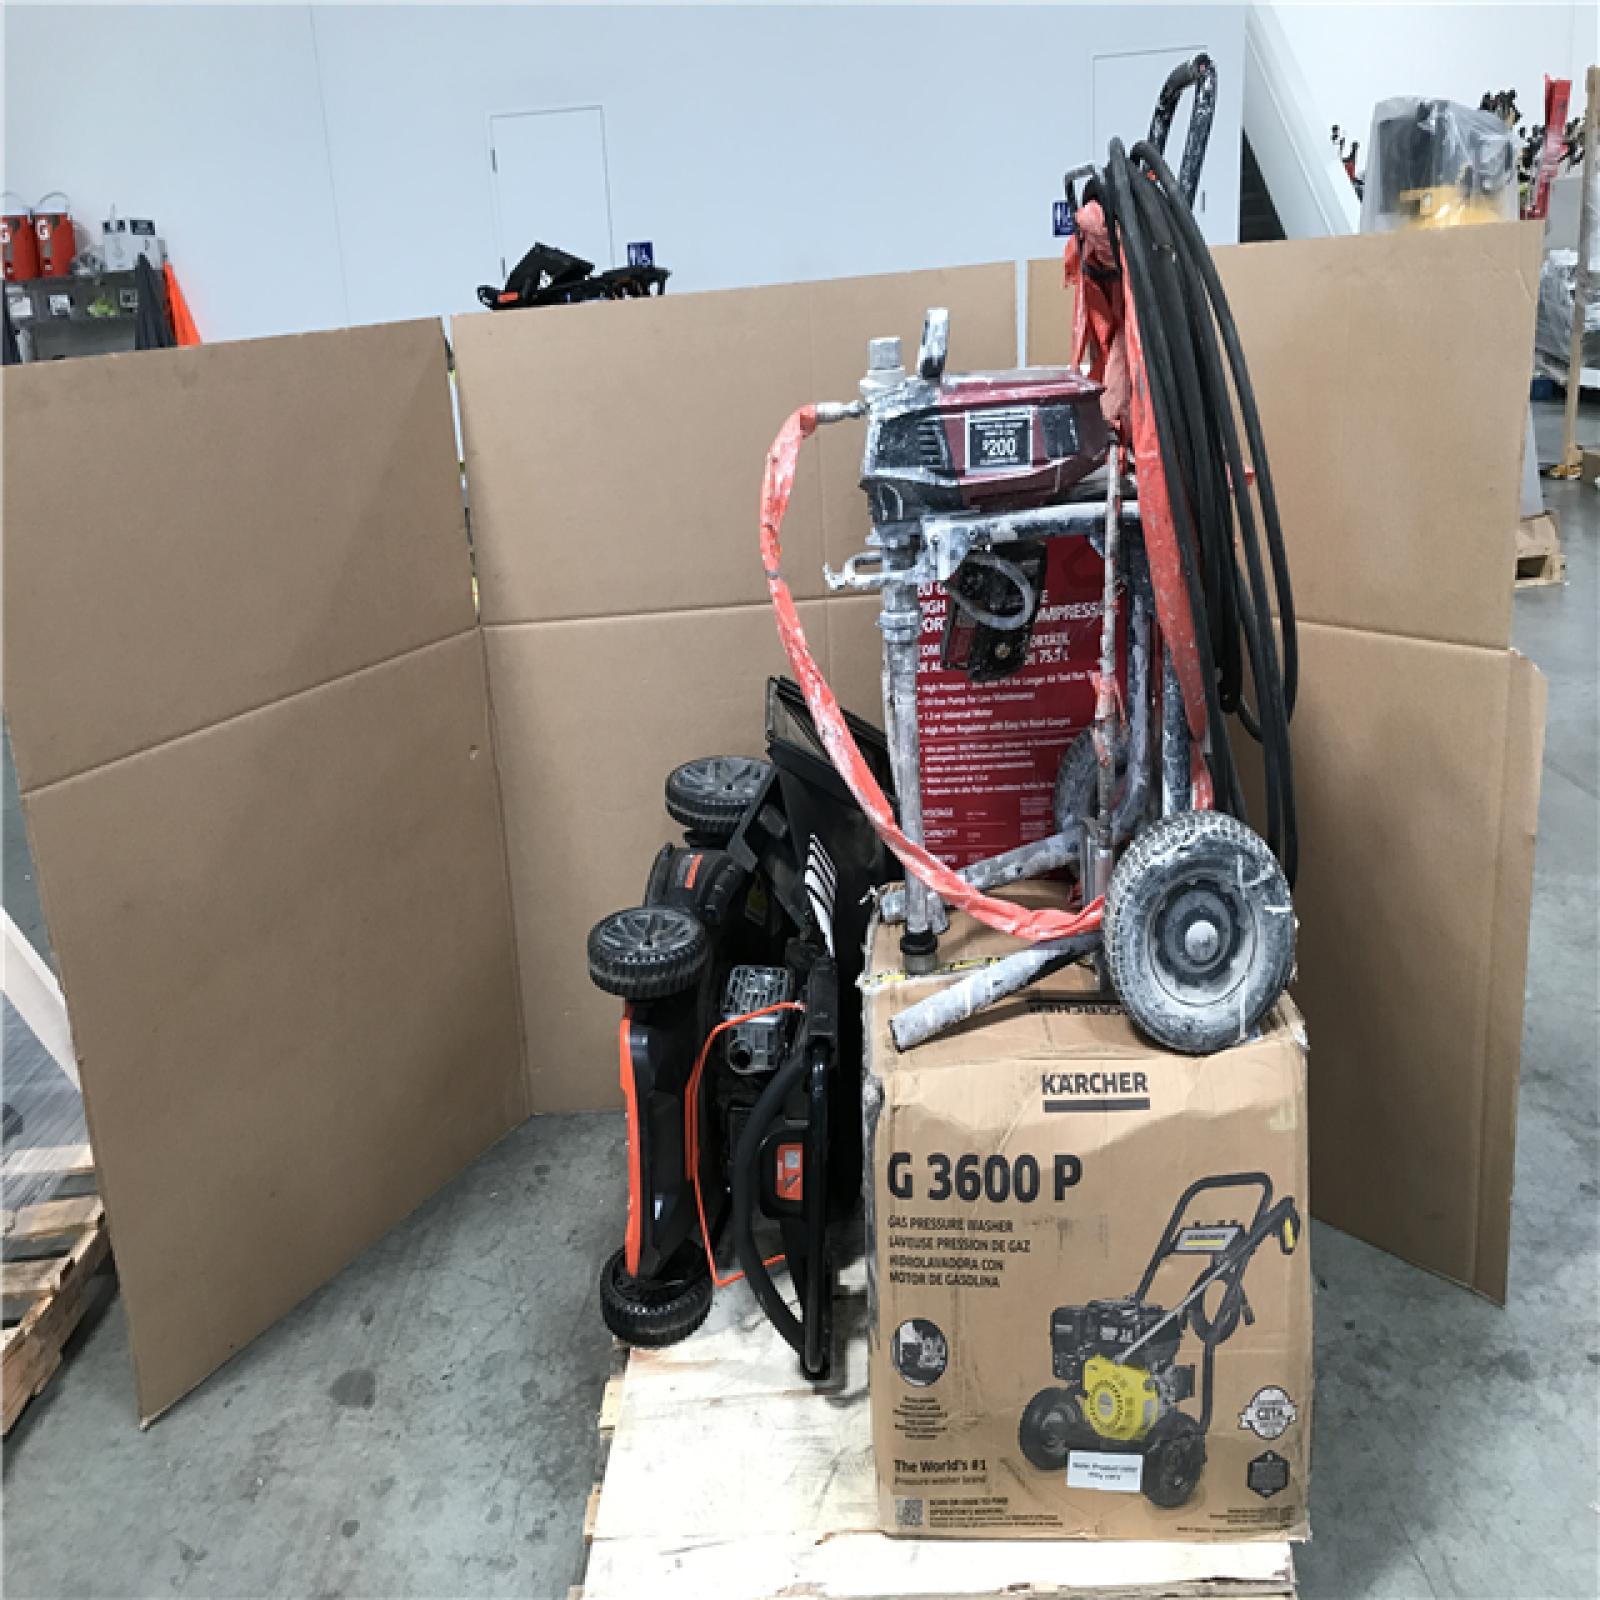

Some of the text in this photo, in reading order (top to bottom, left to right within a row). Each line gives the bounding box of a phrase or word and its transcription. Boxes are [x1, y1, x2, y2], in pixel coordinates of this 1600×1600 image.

[36, 219, 49, 240] G
[1041, 1071, 1148, 1095] KÄRCHER
[888, 1151, 1083, 1203] G 3600 P
[888, 1214, 1014, 1233] GAS PRESSURE WASHER
[889, 1235, 1030, 1253] LAVEUSE PRESSION DE GAZ
[889, 1254, 1004, 1271] HIDROLAVADORA CON
[889, 1271, 1000, 1288] MOTOR DE GASOLINA
[894, 1459, 986, 1473] The World's #1
